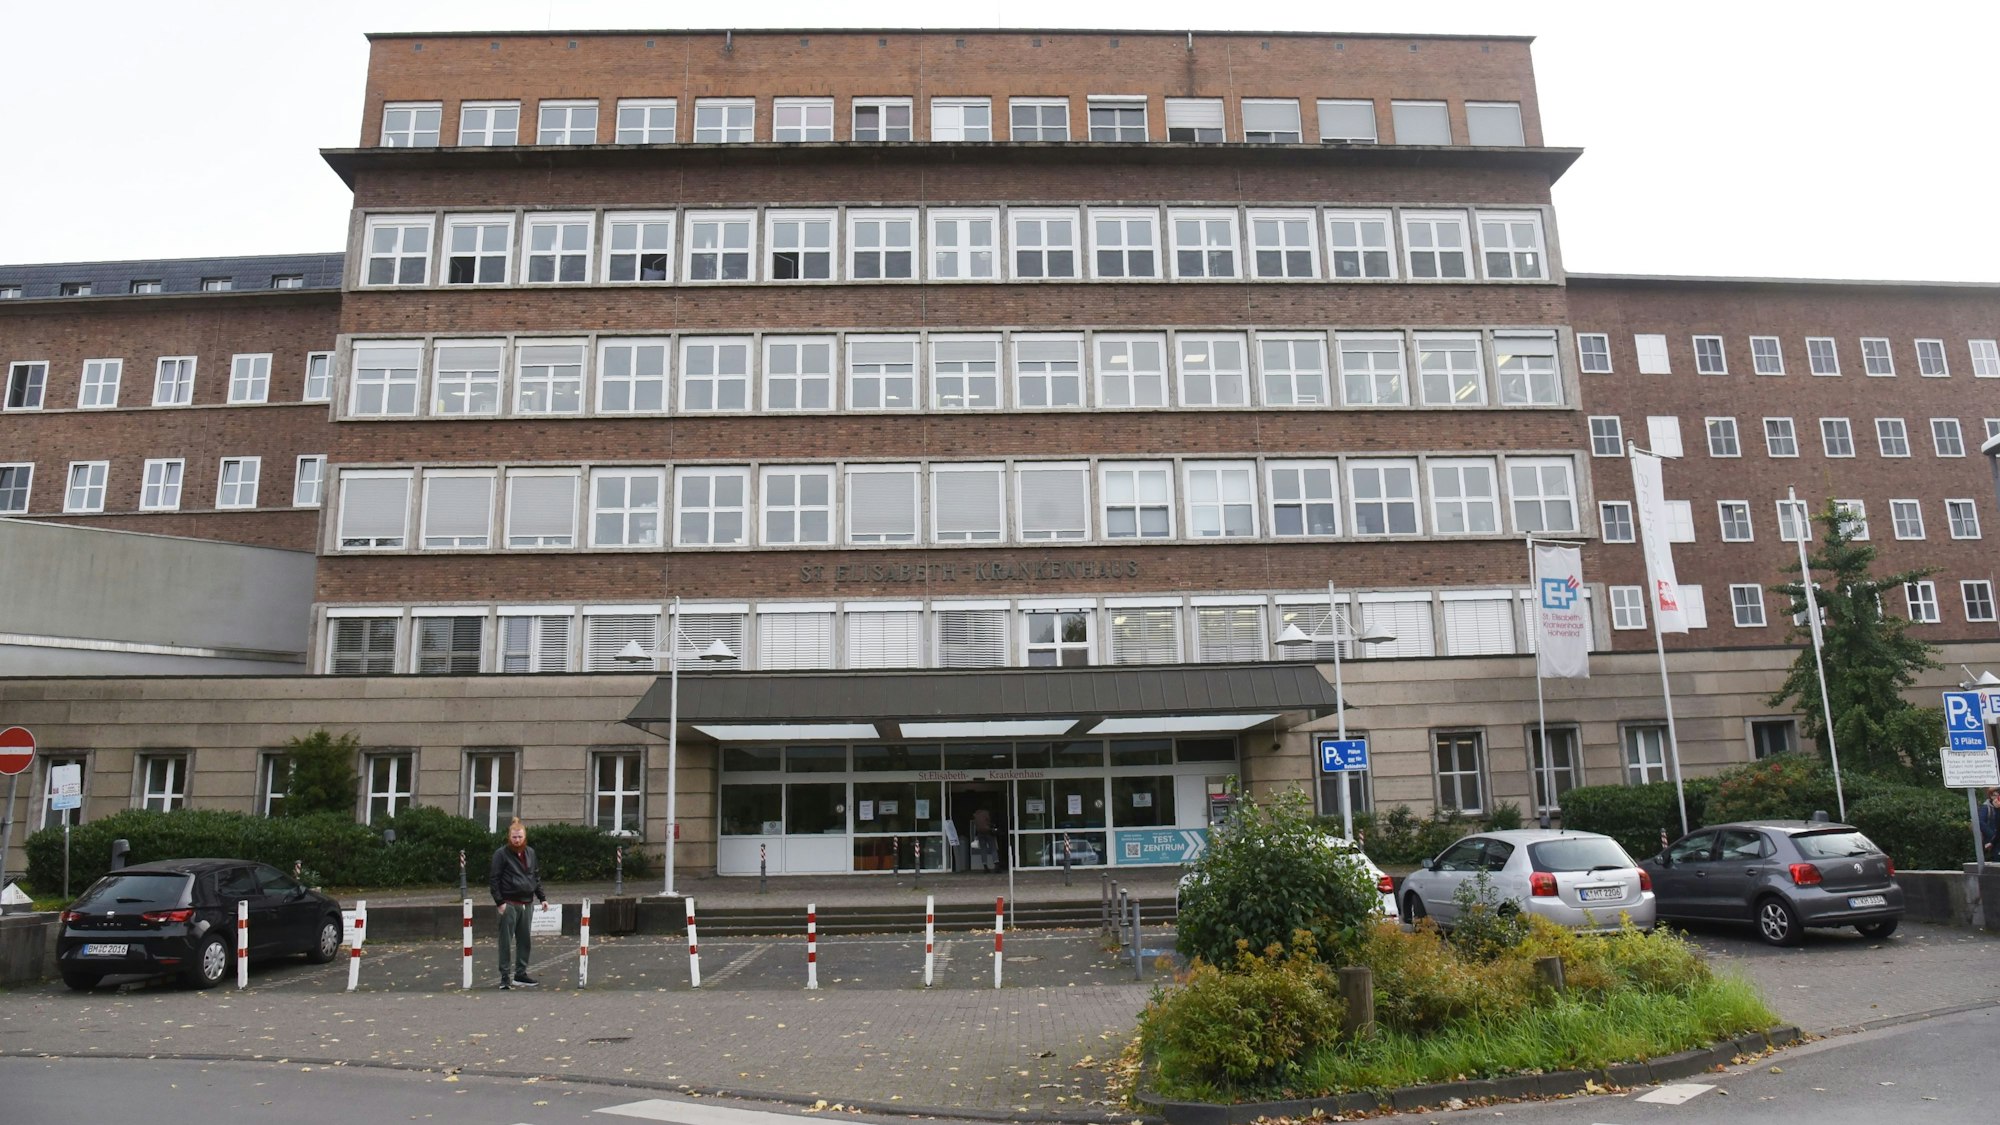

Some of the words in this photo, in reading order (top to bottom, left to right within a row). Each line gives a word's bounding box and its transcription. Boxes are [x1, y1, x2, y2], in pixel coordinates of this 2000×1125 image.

[1947, 696, 1968, 726] P
[1954, 737, 1959, 745] 3
[1961, 736, 1982, 745] Plätze
[1325, 747, 1337, 764] P
[989, 770, 1044, 779] Krankenhaus
[1152, 835, 1175, 843] TEST-
[1143, 843, 1185, 852] ZENTRUM
[108, 944, 126, 953] 2016
